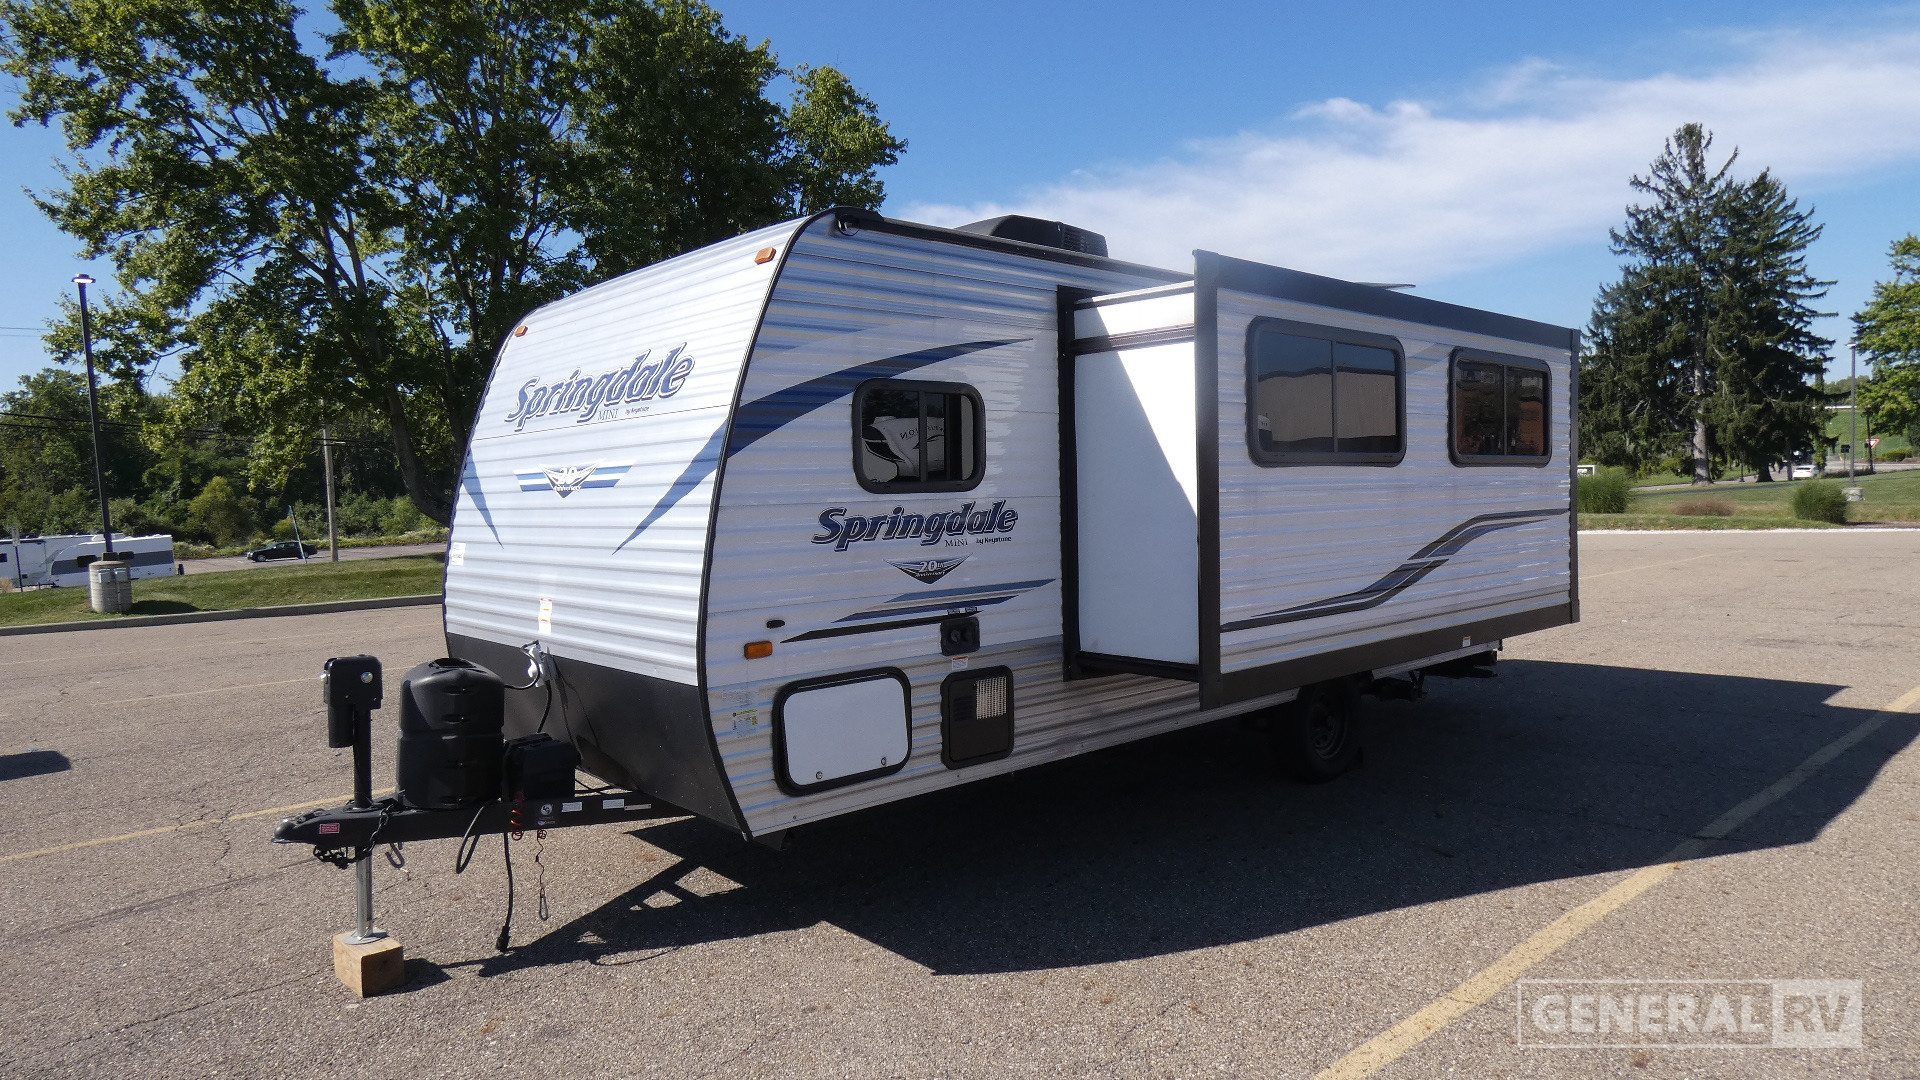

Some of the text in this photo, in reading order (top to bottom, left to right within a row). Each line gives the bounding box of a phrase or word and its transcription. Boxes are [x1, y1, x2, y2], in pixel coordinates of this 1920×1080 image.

[504, 341, 696, 433] Springdale
[597, 408, 619, 421] MINI
[811, 499, 1019, 552] Springdale
[944, 538, 969, 548] MINI
